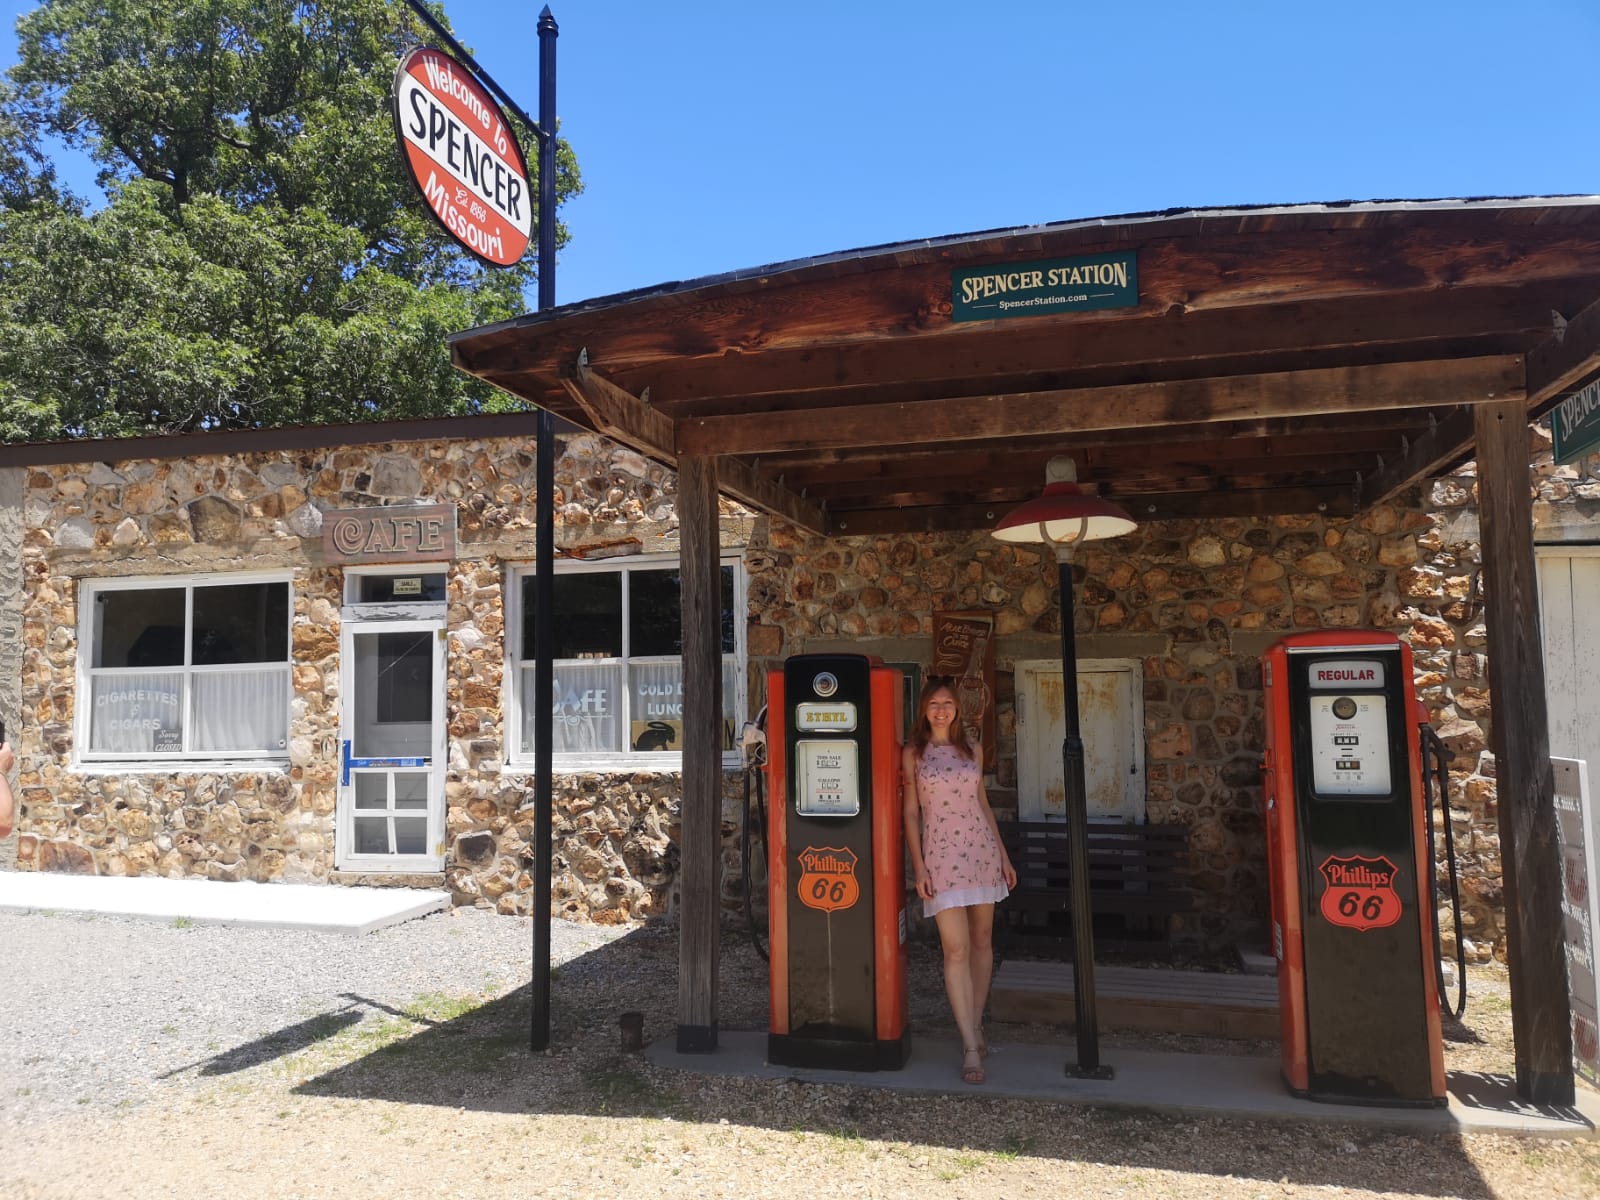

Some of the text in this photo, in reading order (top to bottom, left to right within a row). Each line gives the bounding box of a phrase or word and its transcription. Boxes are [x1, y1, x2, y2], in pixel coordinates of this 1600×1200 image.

[423, 55, 507, 155] Welcome To
[409, 87, 521, 221] SPENCER
[424, 170, 504, 258] Missouri
[961, 262, 1127, 304] SPENCER STATION
[999, 294, 1088, 310] SpencerStation.com
[1561, 378, 1600, 442] SPENC
[333, 514, 445, 555] CAFE
[1317, 670, 1375, 681] REGULAR
[97, 689, 178, 706] CIGARETTES
[639, 683, 673, 697] COLD
[647, 703, 684, 716] LUNC
[806, 711, 848, 722] ETHYL
[111, 719, 161, 731] CIGARS
[804, 854, 851, 875] Phillips
[1327, 864, 1389, 890] Phillips
[812, 878, 847, 903] 66
[1338, 891, 1384, 921] 66
